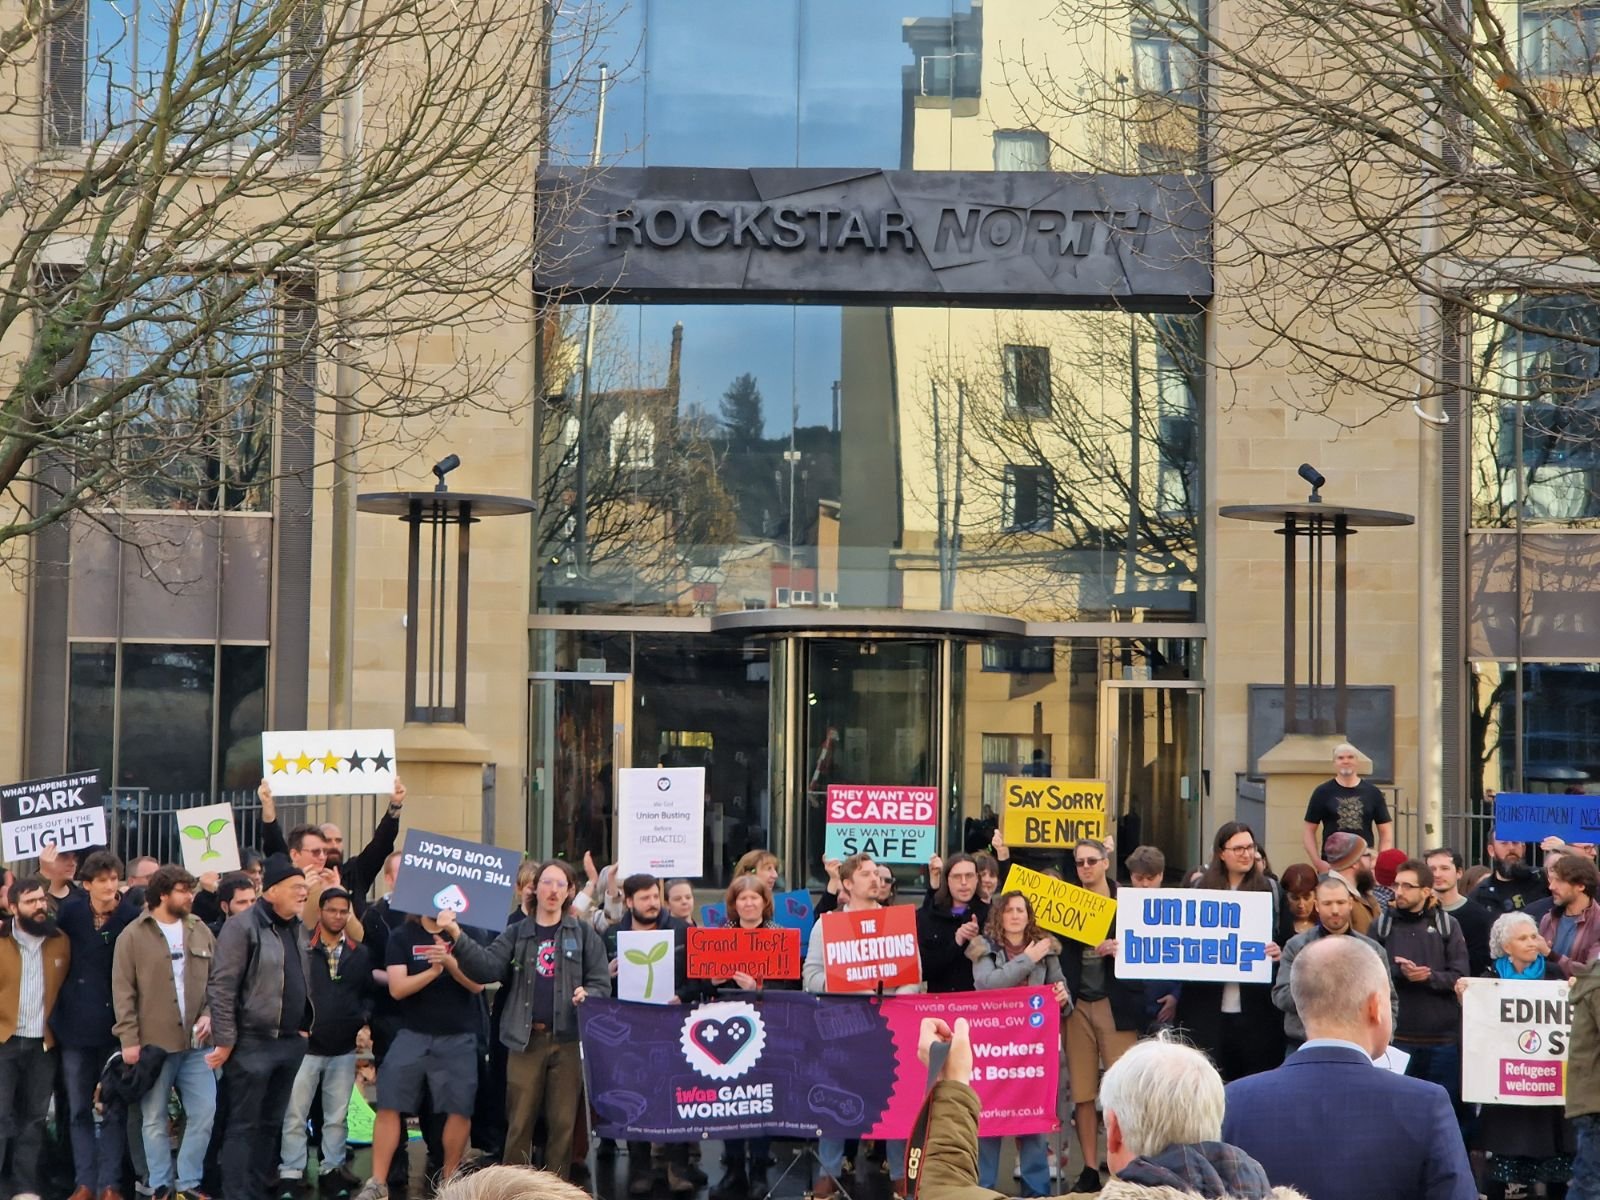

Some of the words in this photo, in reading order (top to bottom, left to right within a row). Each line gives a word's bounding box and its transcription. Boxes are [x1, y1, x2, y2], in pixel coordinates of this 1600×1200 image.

[606, 204, 915, 252] ROCKSTAR
[933, 207, 1152, 256] NORTH
[2, 787, 27, 798] WHAT
[29, 780, 68, 793] HAPPENS
[69, 778, 78, 786] IN
[80, 775, 97, 784] THE
[831, 790, 864, 800] THEY
[867, 790, 904, 800] WANT
[908, 792, 934, 802] YOU
[18, 787, 85, 816] DARK
[1009, 785, 1044, 808] SAY
[636, 812, 660, 820] Union
[661, 812, 690, 821] Busting
[831, 801, 933, 820] SCARED
[15, 822, 44, 832] COMES
[46, 820, 61, 828] OUT
[76, 814, 91, 822] THE
[1025, 817, 1051, 843] BE
[1055, 818, 1100, 843] NICE!
[14, 823, 94, 855] LIGHT
[836, 828, 856, 836] WE
[860, 828, 896, 838] WANT
[901, 829, 926, 838] YOU
[419, 841, 462, 860] BACK!
[843, 837, 917, 858] SAFE
[404, 854, 434, 870] HAS
[465, 850, 502, 869] YOUR
[436, 861, 482, 880] UNION
[484, 871, 512, 886] THE
[1048, 880, 1066, 898] NO
[1070, 889, 1106, 912] OTHER
[860, 920, 876, 934] THE
[692, 930, 738, 952] Grand
[744, 931, 789, 953] Theft
[826, 934, 914, 966] PINKERTONS
[1124, 929, 1266, 972] busted?
[846, 965, 877, 982] SALUTE
[915, 1004, 945, 1012] IWGB
[948, 1003, 978, 1012] Game
[982, 1000, 1024, 1010] Workers
[968, 1016, 1025, 1028] IWGB_GW
[972, 1042, 1045, 1058] Workers
[1548, 1030, 1571, 1055] S
[970, 1066, 982, 1080] t
[986, 1066, 1045, 1080] Bosses
[1505, 1062, 1556, 1078] Refugees
[718, 1083, 774, 1101] GAME
[1506, 1079, 1556, 1092] welcome
[677, 1099, 774, 1119] WORKERS
[908, 1147, 922, 1180] EOS
